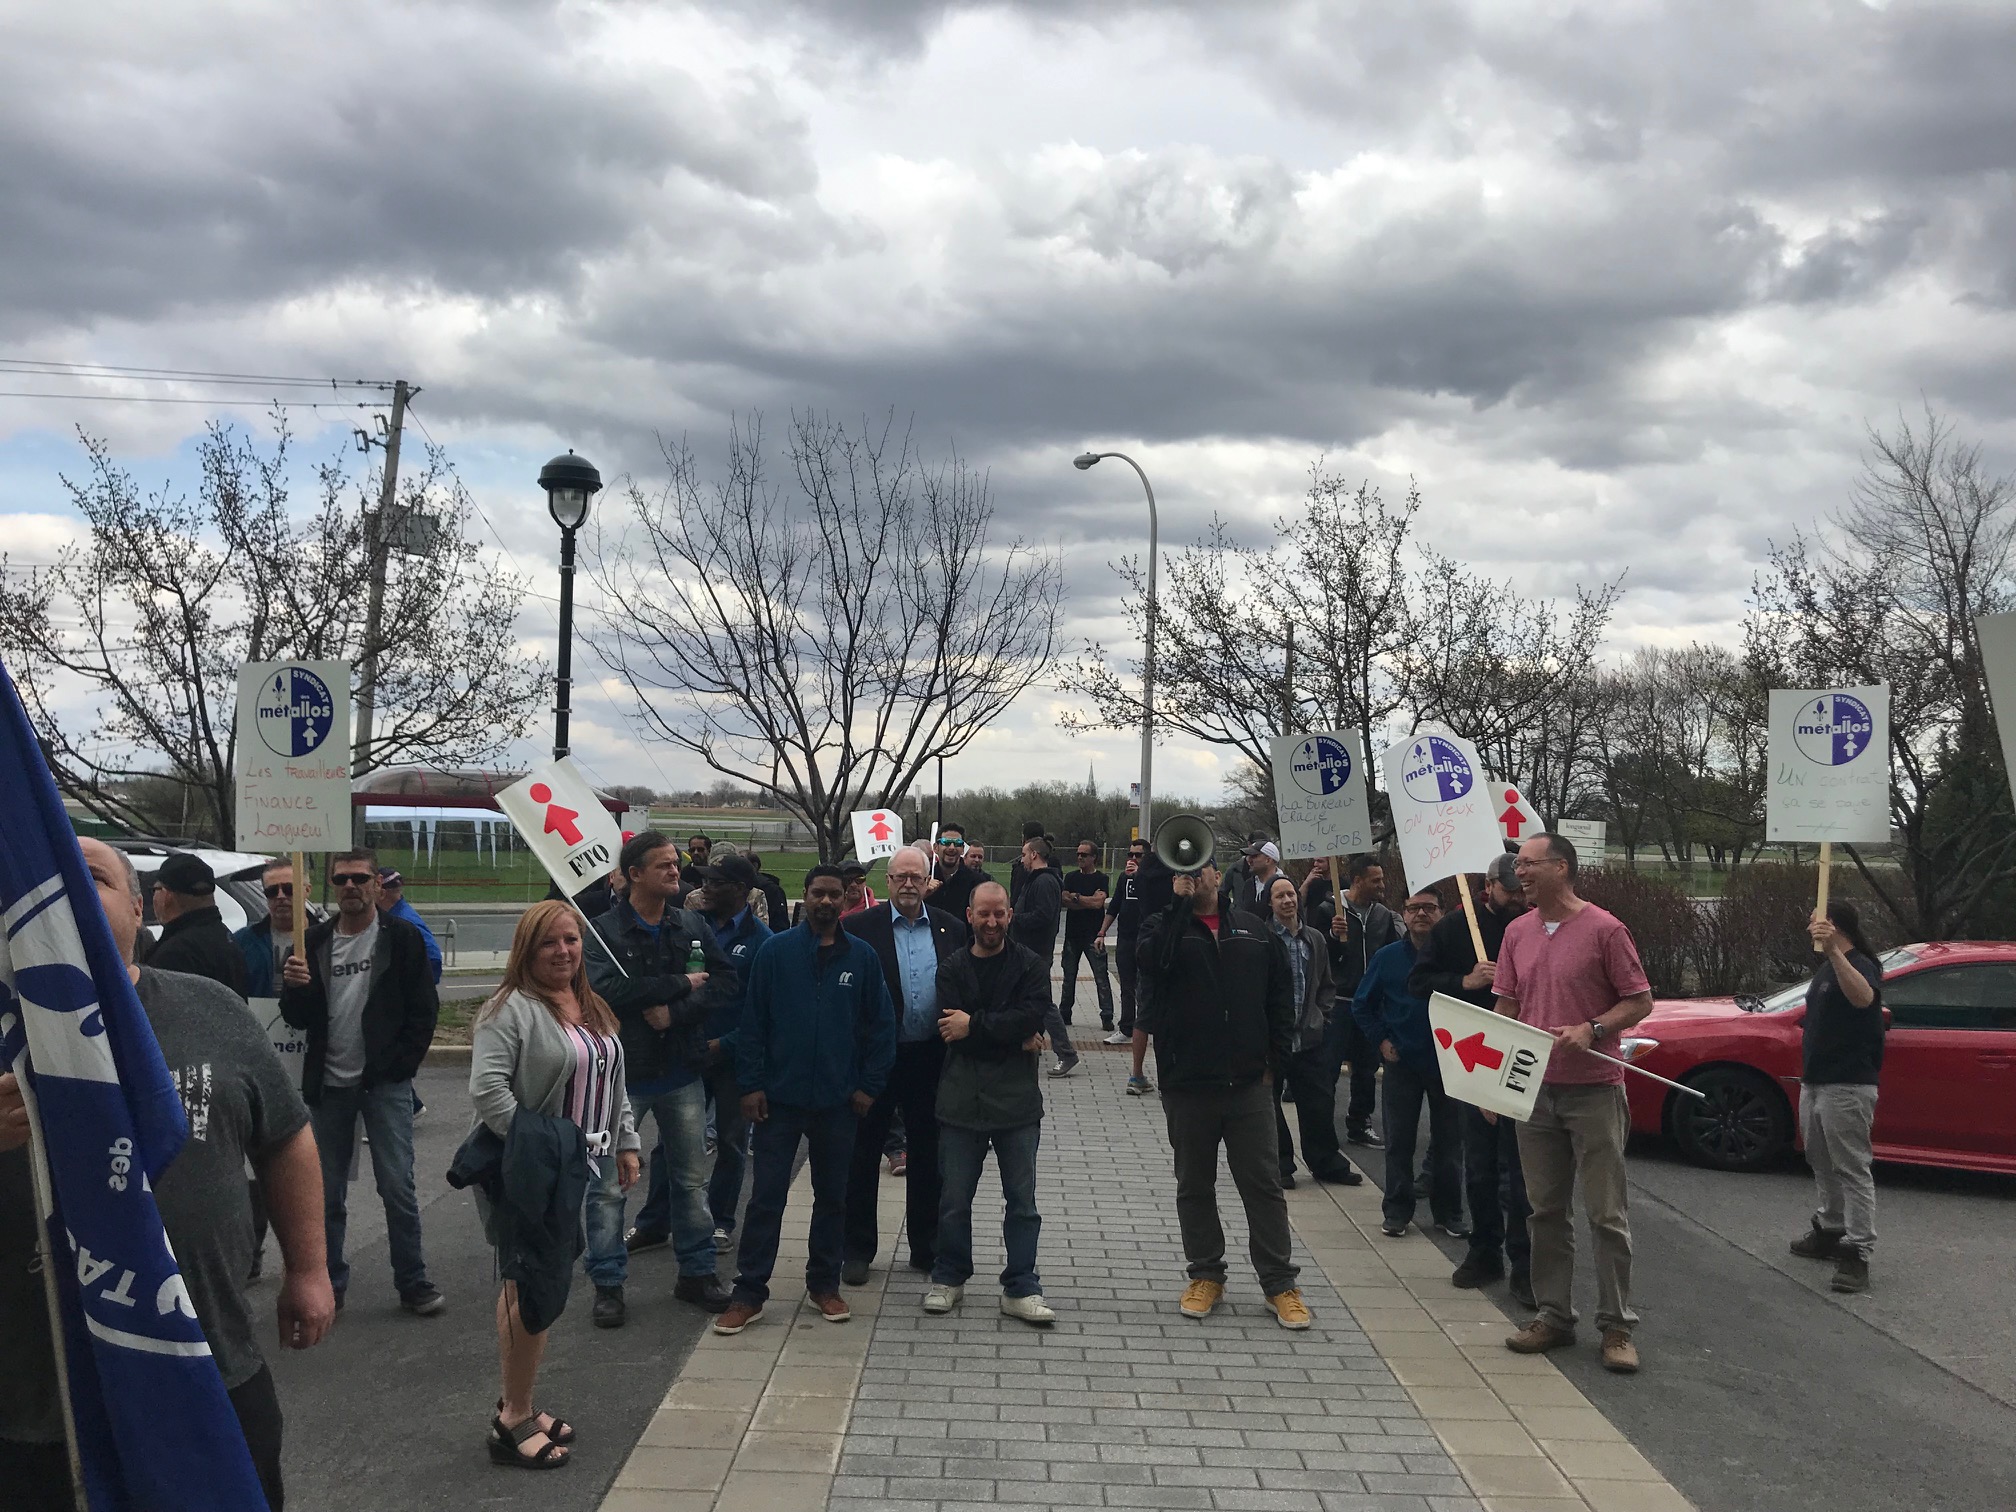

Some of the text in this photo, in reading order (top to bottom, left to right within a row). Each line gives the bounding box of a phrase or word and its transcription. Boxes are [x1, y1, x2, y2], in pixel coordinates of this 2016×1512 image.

[293, 670, 330, 704] SYNDICAT
[260, 700, 331, 719] métallos
[1834, 696, 1870, 722] SYNDICAT
[1798, 719, 1871, 735] métallos
[1317, 738, 1348, 759] SYNDICAT
[1430, 738, 1468, 767] SYNDICAT
[1293, 756, 1350, 773] métallos
[1405, 759, 1471, 784] métallos
[567, 843, 611, 879] FTQ
[1505, 1048, 1539, 1095] FTQ
